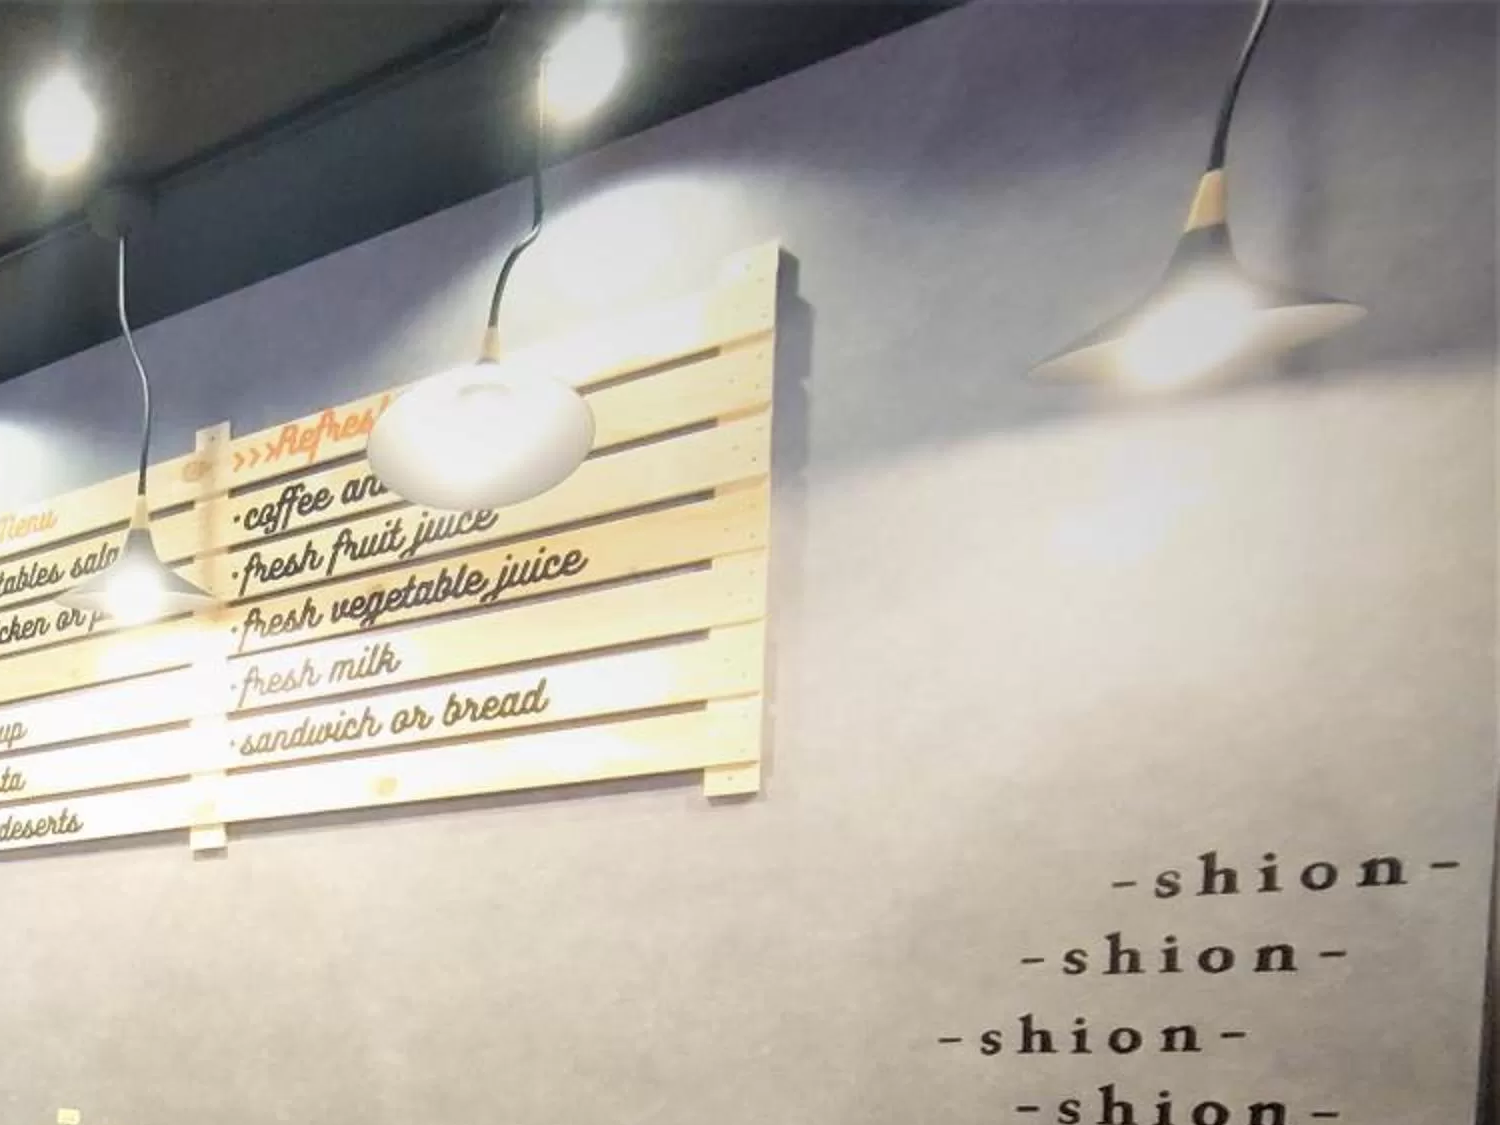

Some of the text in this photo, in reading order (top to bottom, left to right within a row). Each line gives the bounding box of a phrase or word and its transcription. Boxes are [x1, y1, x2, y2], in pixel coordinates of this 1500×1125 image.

[243, 474, 389, 534] coffee an
[69, 541, 120, 580] sala
[239, 505, 499, 596] fresh fruit juice
[55, 607, 87, 631] or
[238, 545, 589, 653] fresh vegetable juice
[238, 641, 402, 708] fresh milk
[240, 678, 550, 755] sandwich or bread
